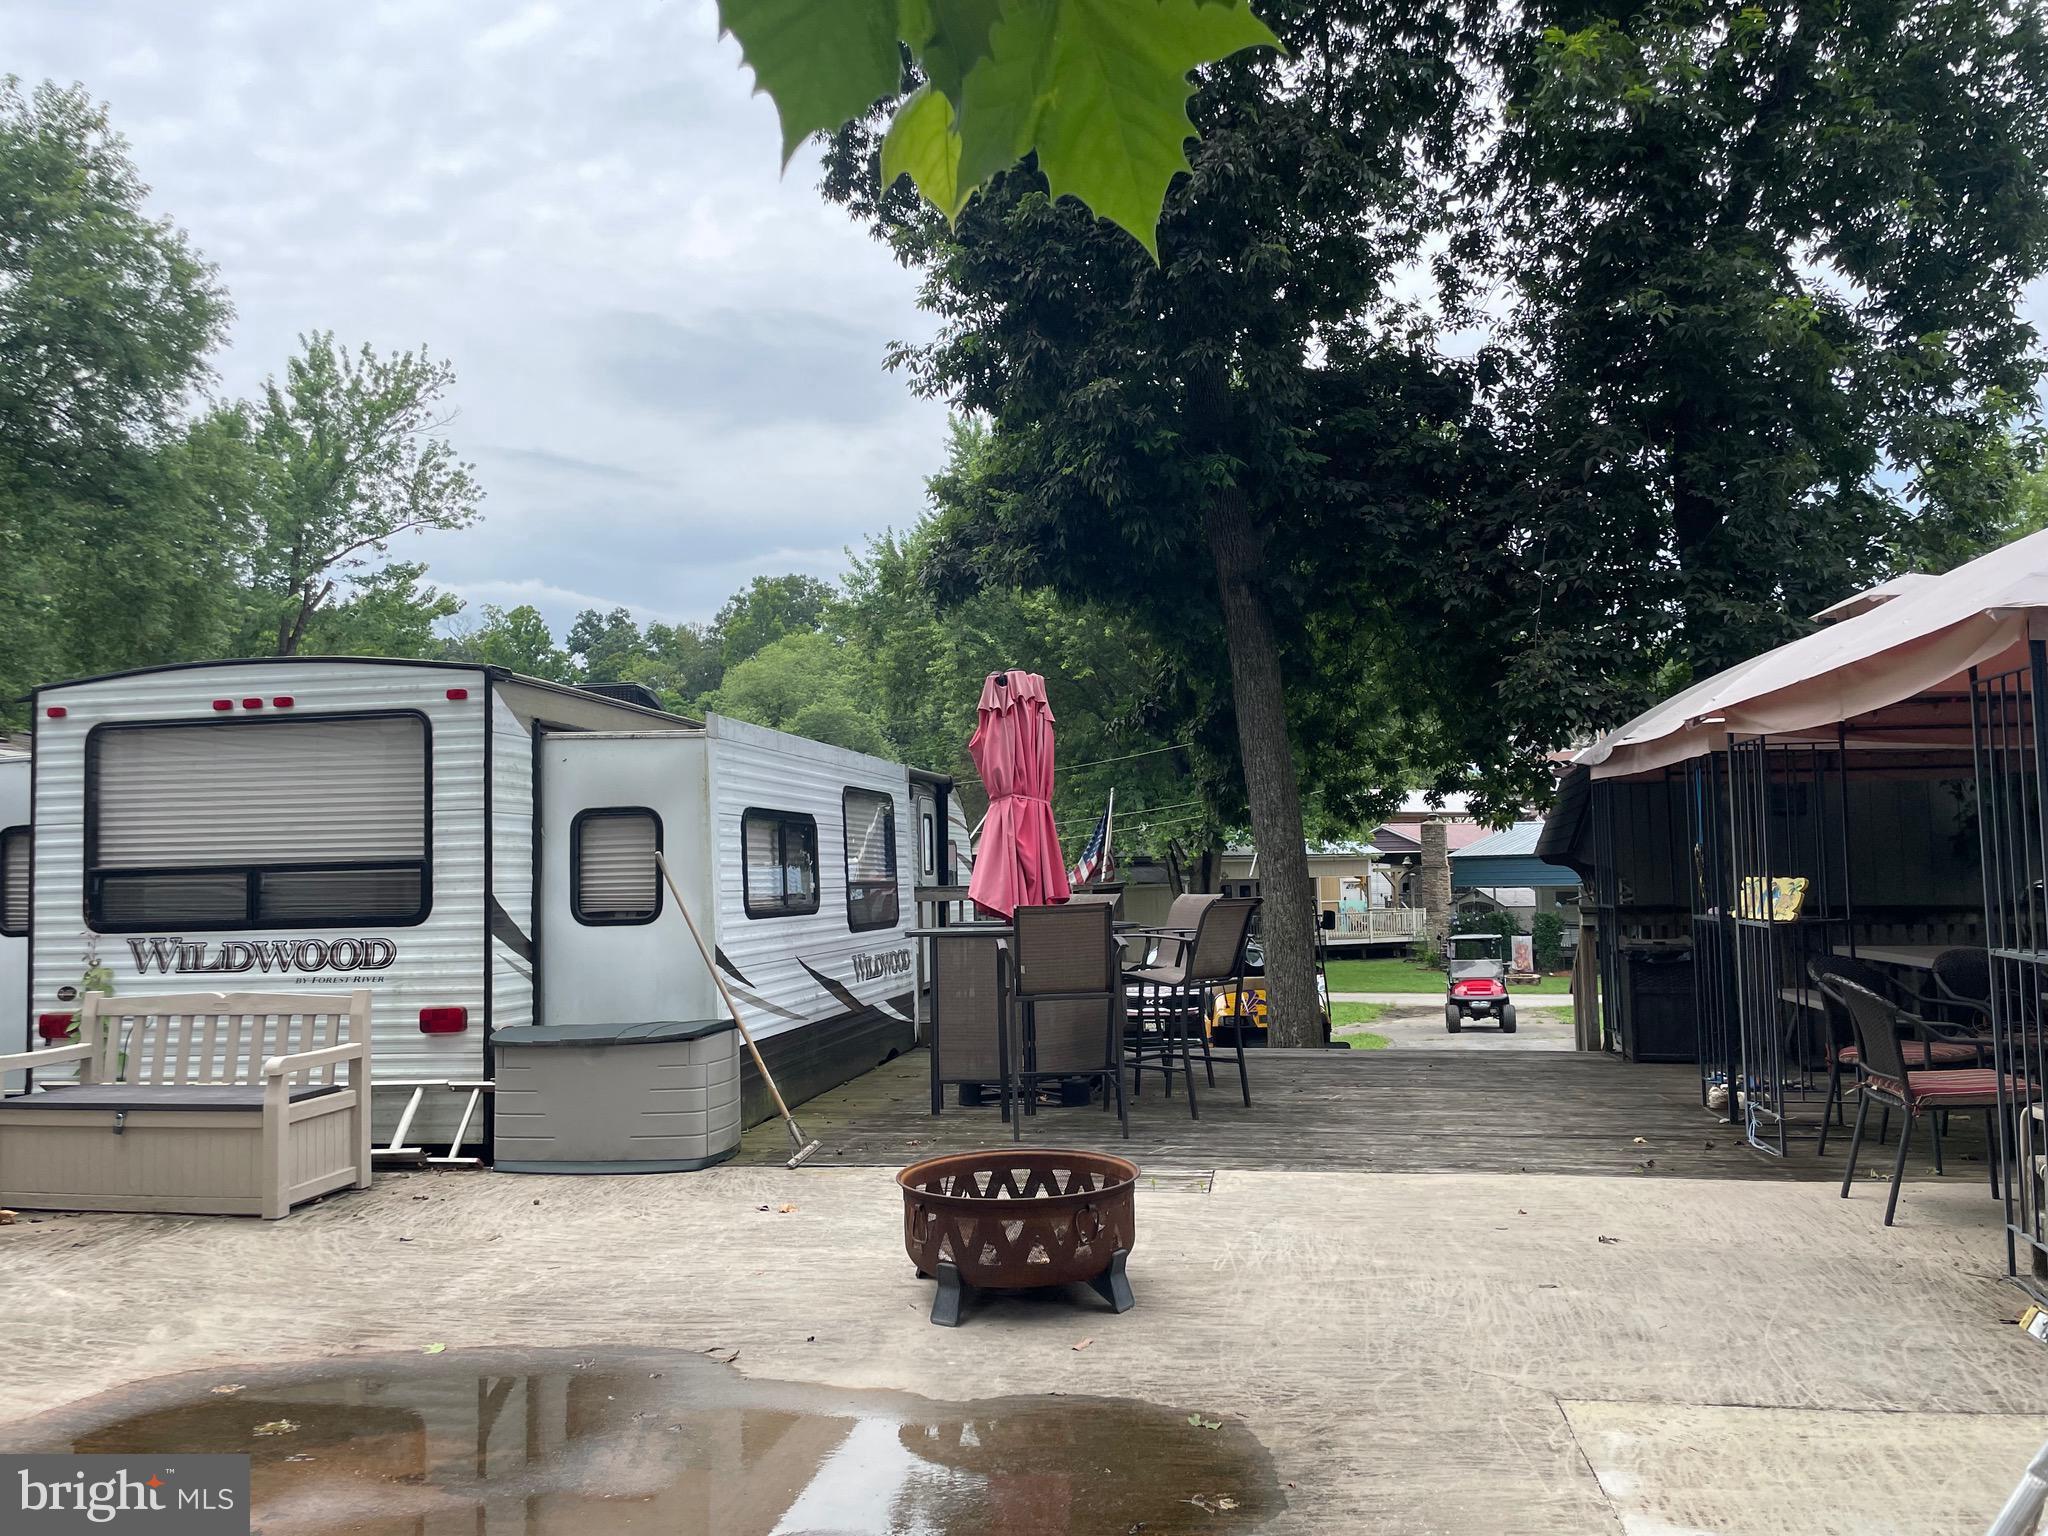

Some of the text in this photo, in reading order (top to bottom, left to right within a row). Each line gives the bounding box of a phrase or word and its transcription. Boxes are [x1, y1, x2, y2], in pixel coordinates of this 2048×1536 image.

[127, 937, 397, 974] WILDWOOD
[851, 949, 911, 983] WILDWOOD
[295, 975, 385, 985] BY FOREST RIVER
